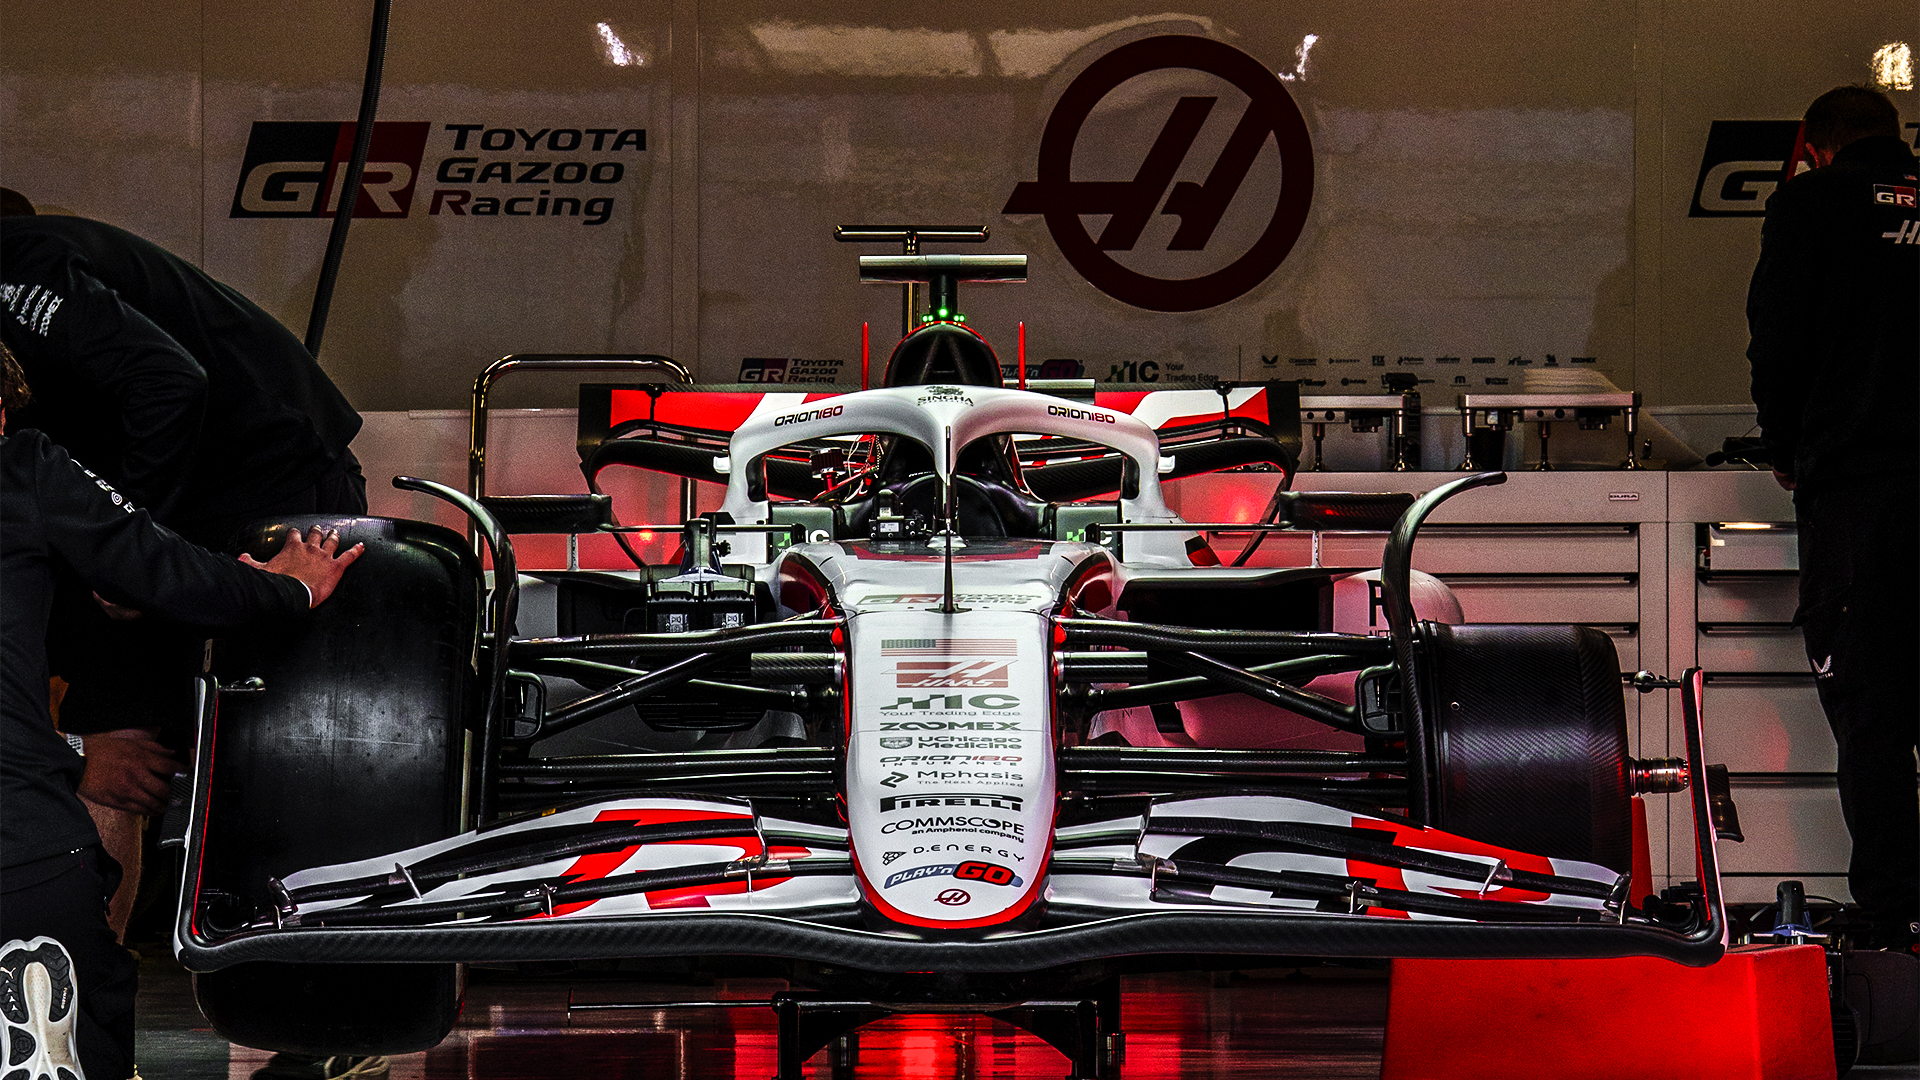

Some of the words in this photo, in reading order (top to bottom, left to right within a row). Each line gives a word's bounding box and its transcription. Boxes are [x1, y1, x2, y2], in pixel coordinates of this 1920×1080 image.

[445, 124, 647, 151] TOYOTA
[436, 157, 624, 184] GAZOO
[240, 161, 413, 212] GR
[1876, 192, 1914, 206] GR
[428, 189, 614, 225] Racing
[792, 358, 844, 367] TOYOTA
[1165, 362, 1184, 371] Your
[1372, 355, 1385, 364] FIX
[740, 368, 784, 382] GR
[790, 367, 838, 375] GAZOO
[1165, 374, 1196, 383] Trading
[1197, 373, 1219, 383] Edge
[788, 375, 836, 384] Racing
[917, 395, 974, 405] SINGHA
[774, 405, 843, 426] ORION180
[1048, 405, 1116, 424] ORION180
[911, 678, 995, 687] HAAS
[880, 722, 1021, 731] ZOOMEX
[880, 755, 1022, 763] ORION180
[917, 770, 1023, 781] Mphasis
[880, 793, 1024, 813] PIRELLI
[880, 816, 1025, 836] COMMSCOPE
[980, 828, 1024, 843] company
[956, 862, 1013, 884] GO
